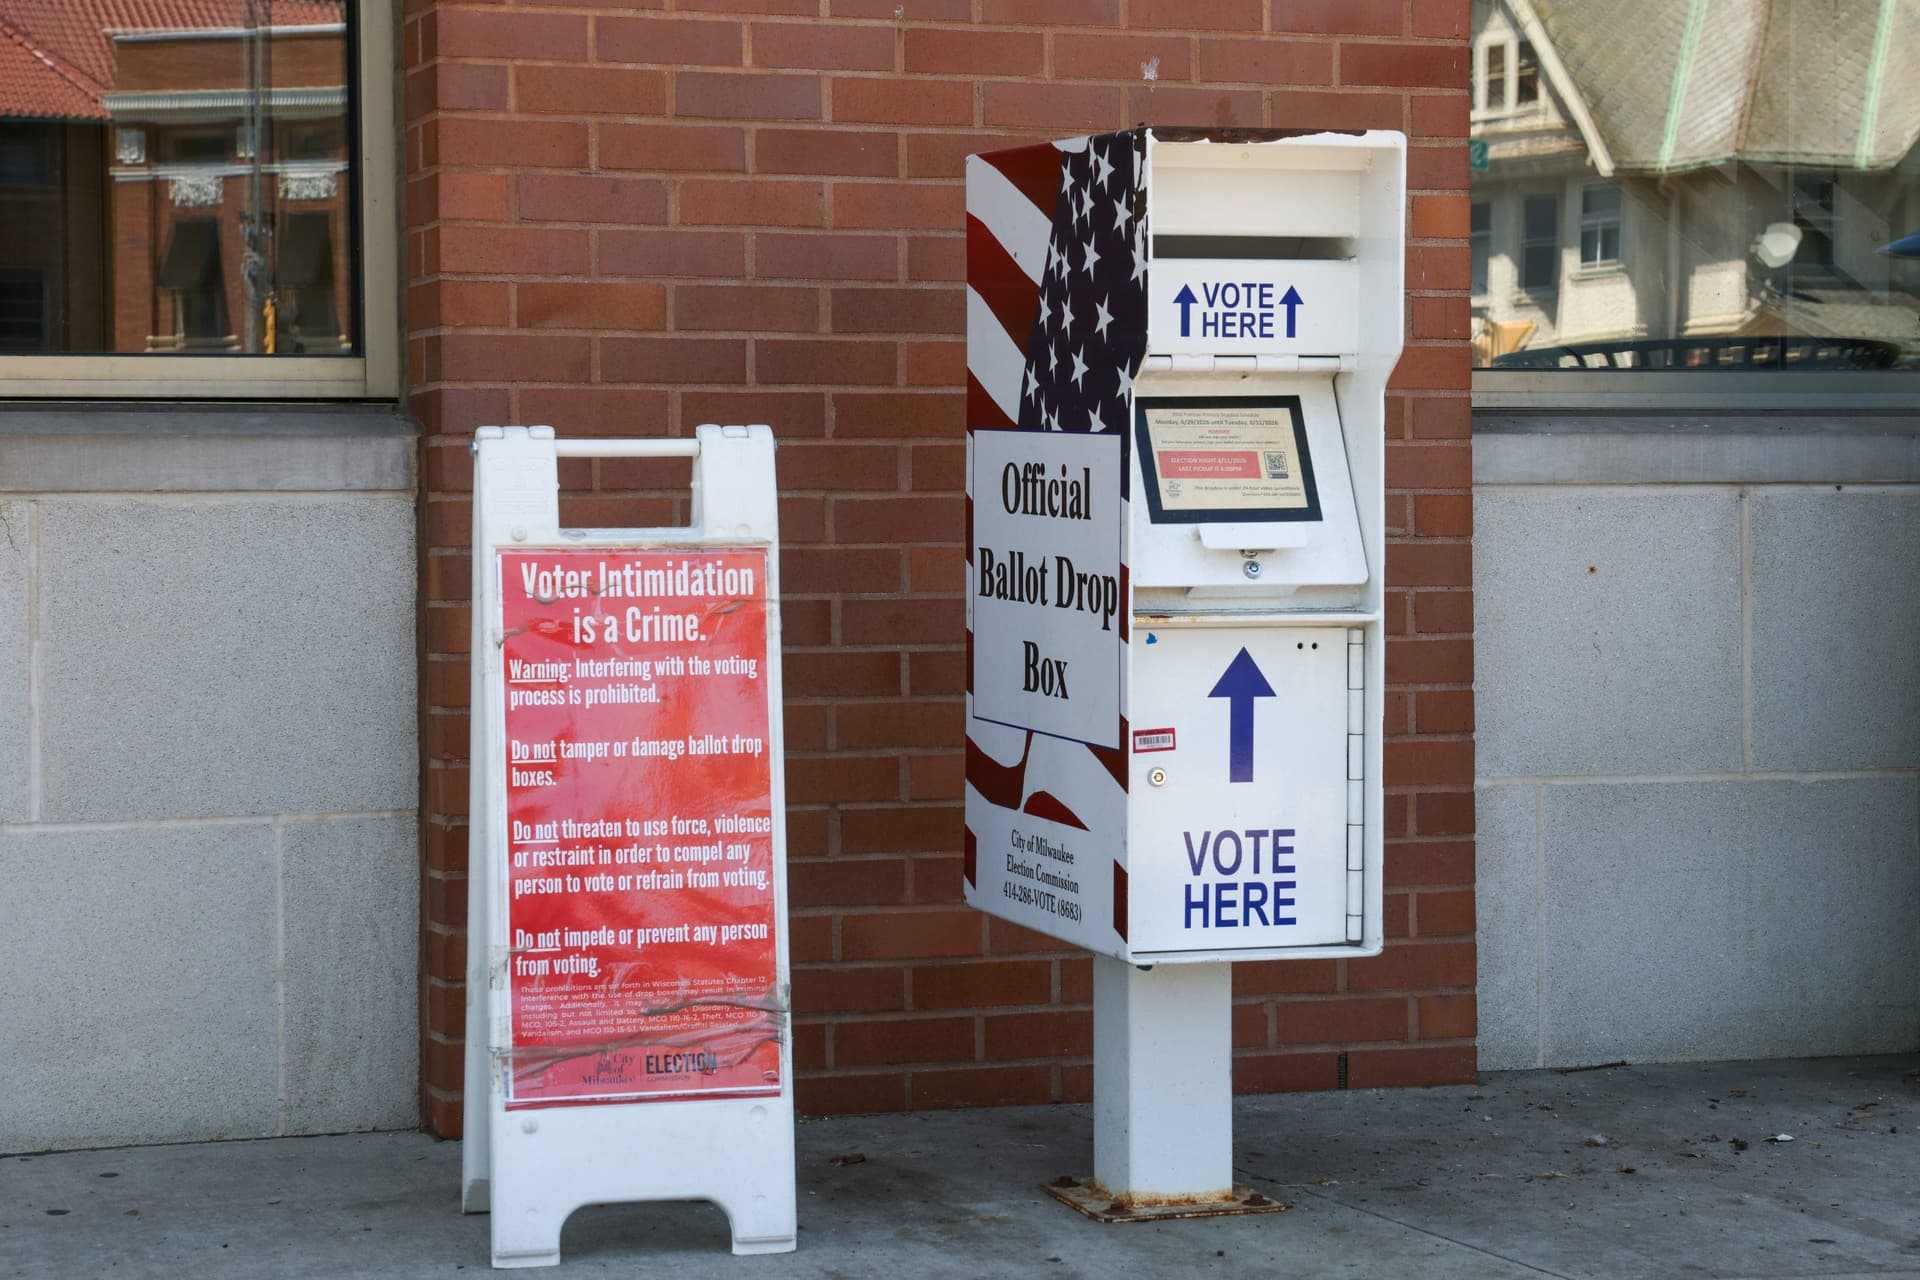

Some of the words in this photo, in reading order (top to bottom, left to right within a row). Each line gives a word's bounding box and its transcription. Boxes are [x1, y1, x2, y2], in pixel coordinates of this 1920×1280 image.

[1202, 282, 1274, 309] VOTE
[1202, 312, 1275, 338] HERE
[1002, 462, 1092, 520] Official
[521, 562, 592, 599] Voter
[600, 560, 754, 597] Intimidation
[978, 547, 1049, 606] Ballot
[1054, 555, 1118, 631] Drop
[573, 607, 595, 643] is
[604, 619, 618, 642] a
[626, 606, 706, 642] Crime.
[509, 658, 572, 683] Warning:
[576, 657, 651, 680] Interfering
[654, 655, 684, 677] with
[688, 655, 711, 676] the
[714, 655, 757, 678] voting
[1022, 640, 1069, 700] Box
[510, 687, 565, 710] process
[569, 685, 581, 705] is
[585, 683, 660, 708] prohibited.
[511, 739, 529, 760] Do
[533, 740, 556, 760] not
[560, 739, 609, 762] tamper
[614, 742, 628, 758] or
[631, 736, 684, 760] damage
[688, 735, 728, 755] ballot
[731, 733, 762, 758] drop
[512, 766, 557, 787] boxes.
[513, 820, 531, 840] Do
[535, 821, 558, 840] not
[561, 818, 622, 839] threaten
[625, 818, 640, 837] to
[643, 819, 668, 837] use
[672, 815, 711, 838] force,
[714, 814, 771, 834] violence
[514, 850, 529, 868] or
[533, 847, 594, 867] restraint
[598, 846, 612, 866] in
[615, 845, 653, 865] order
[656, 843, 671, 863] to
[674, 841, 723, 866] compel
[726, 844, 751, 864] any
[1011, 828, 1025, 853] City
[1027, 835, 1035, 853] of
[1036, 836, 1074, 865] Milwaukee
[1183, 829, 1296, 876] VOTE
[515, 877, 562, 899] person
[566, 873, 581, 893] to
[584, 872, 615, 892] vote
[618, 875, 632, 891] or
[636, 870, 684, 890] refrain
[687, 868, 720, 889] from
[723, 867, 770, 890] voting.
[1006, 853, 1034, 879] Election
[1036, 864, 1079, 894] Commission
[1003, 880, 1056, 914] 414-286-VOTE
[1058, 898, 1082, 925] (8683)
[1184, 881, 1297, 929] HERE
[515, 929, 534, 950] Do
[538, 928, 561, 949] not
[564, 926, 615, 951] impede
[619, 928, 633, 944] or
[637, 924, 690, 949] prevent
[693, 925, 717, 947] any
[721, 923, 768, 946] person
[515, 956, 550, 976] from
[553, 953, 601, 978] voting.
[692, 978, 724, 986] Statutes
[726, 977, 756, 985] Chapter
